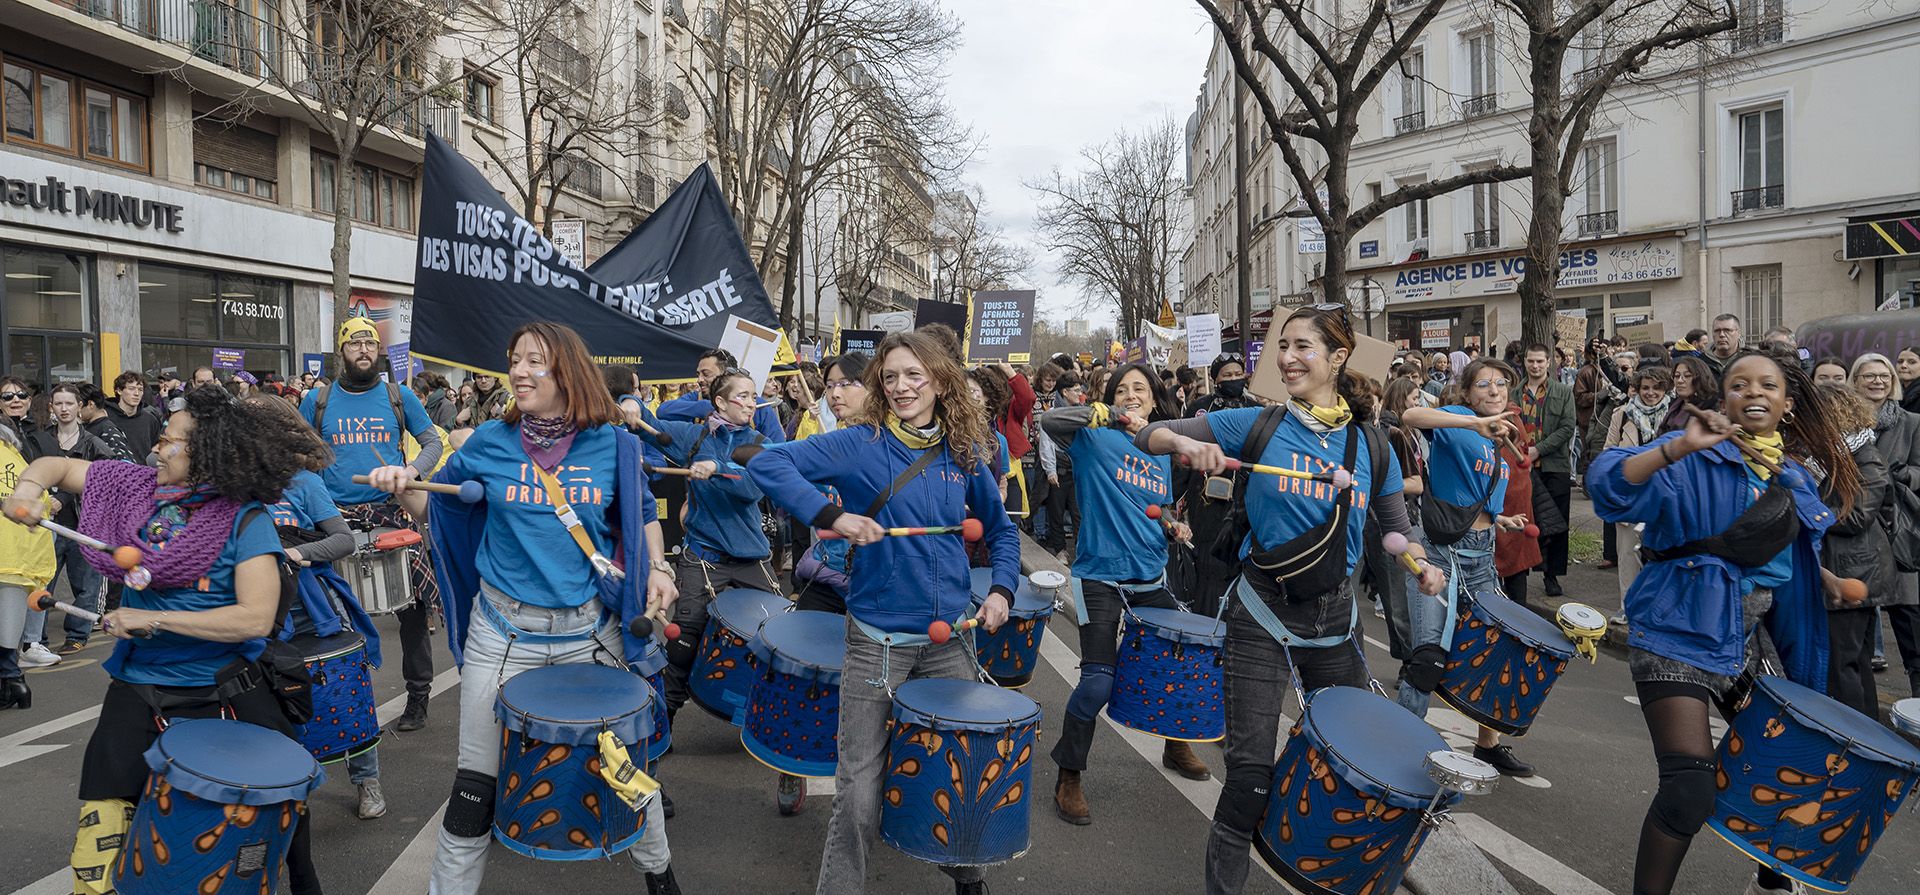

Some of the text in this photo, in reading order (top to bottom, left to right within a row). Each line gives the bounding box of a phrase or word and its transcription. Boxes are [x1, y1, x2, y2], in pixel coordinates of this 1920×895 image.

[74, 186, 184, 233] MINUTE
[1300, 242, 1325, 252] 01 43 66
[422, 236, 450, 272] DES
[453, 241, 507, 282] VISAS
[1395, 263, 1467, 287] AGENCE
[1471, 260, 1497, 279] DE
[1500, 247, 1598, 277] VOGES
[1608, 267, 1676, 282] 01 43 66 45 51
[1283, 296, 1304, 304] TRYBA
[231, 301, 284, 319] 43 58.70.70
[981, 310, 1020, 318] AFGHANES
[981, 319, 1019, 328] DES VISAS
[979, 328, 1022, 336] POUR LEUR
[1429, 329, 1449, 337] LOUER
[978, 336, 1010, 345] LIBERTÉ
[332, 432, 390, 445] DRUMTEAM
[505, 485, 602, 505] DRUTEAM
[1279, 475, 1366, 509] DRUMTAM
[460, 791, 482, 803] ALLSIX
